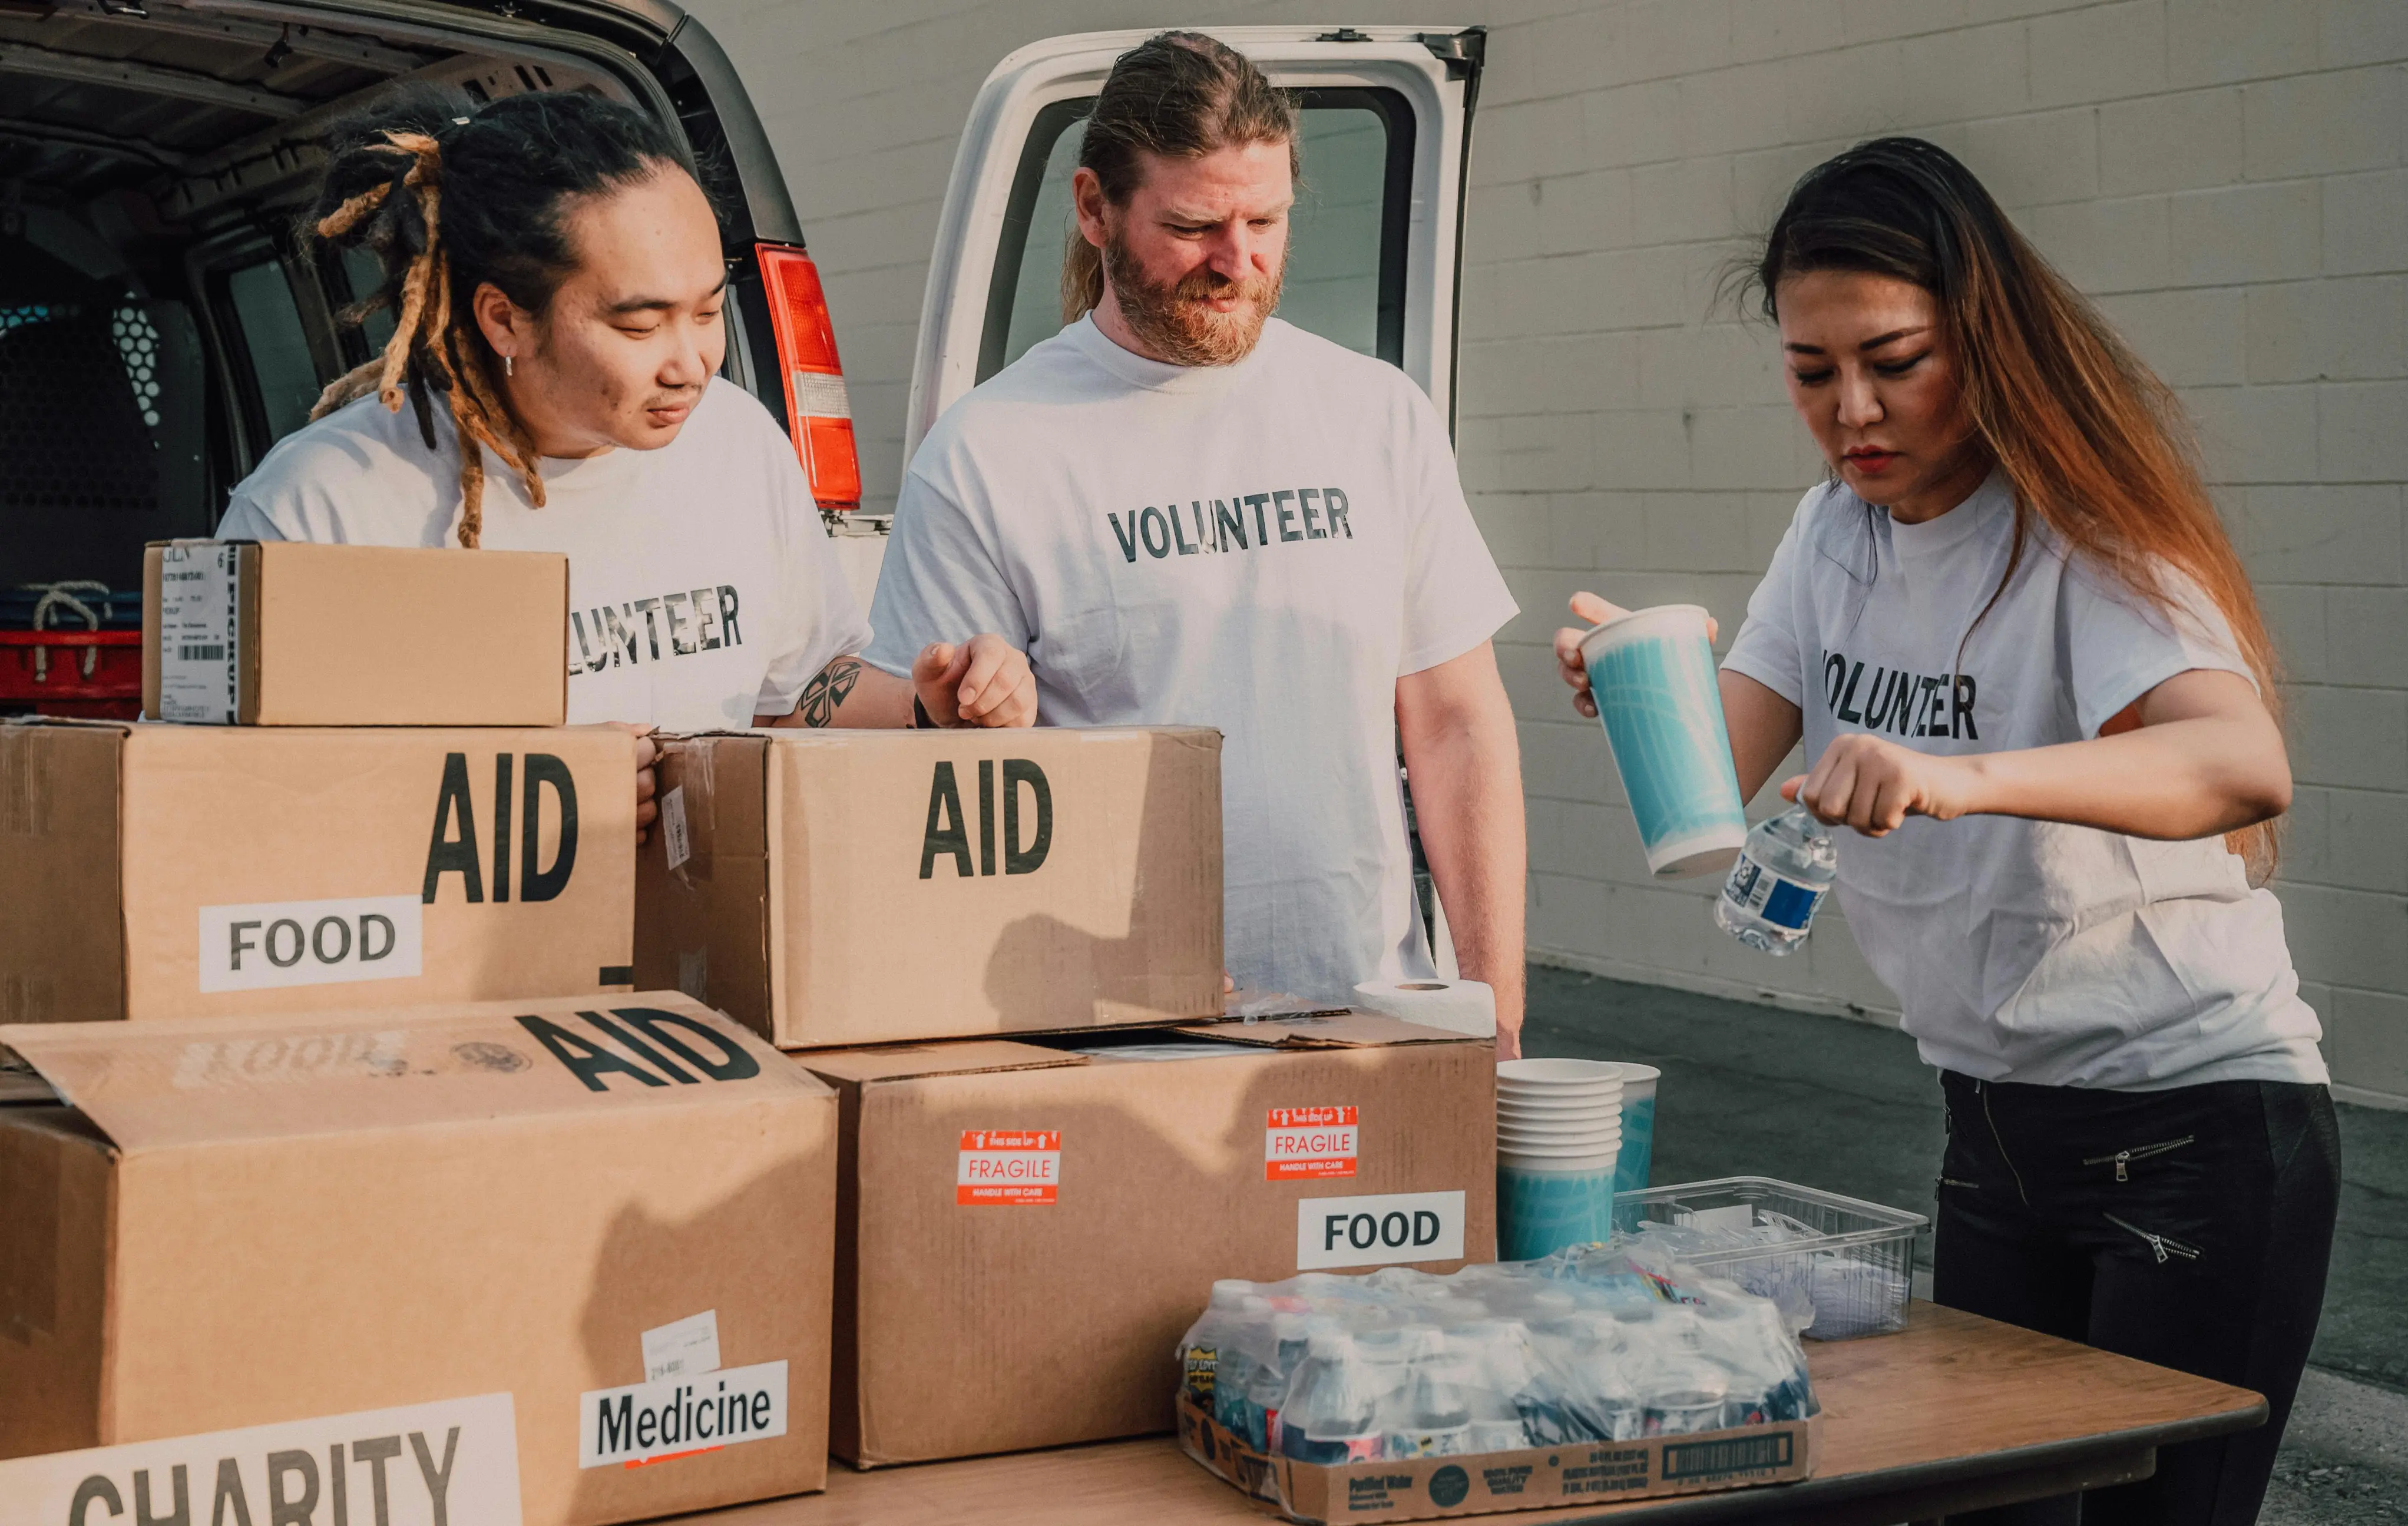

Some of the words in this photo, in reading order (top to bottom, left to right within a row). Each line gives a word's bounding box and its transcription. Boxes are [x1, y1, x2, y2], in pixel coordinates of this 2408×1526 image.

[1107, 488, 1353, 563] VOLUNTEER
[422, 753, 578, 904] AID
[919, 759, 1053, 879] AID
[230, 914, 395, 971] FOOD
[514, 1007, 761, 1091] AID
[968, 1159, 1051, 1178] FRAGILE
[1275, 1133, 1350, 1154] FRAGILE
[1307, 1162, 1324, 1171] WITH
[1325, 1211, 1440, 1250] FOOD
[598, 1381, 770, 1455] Medicine
